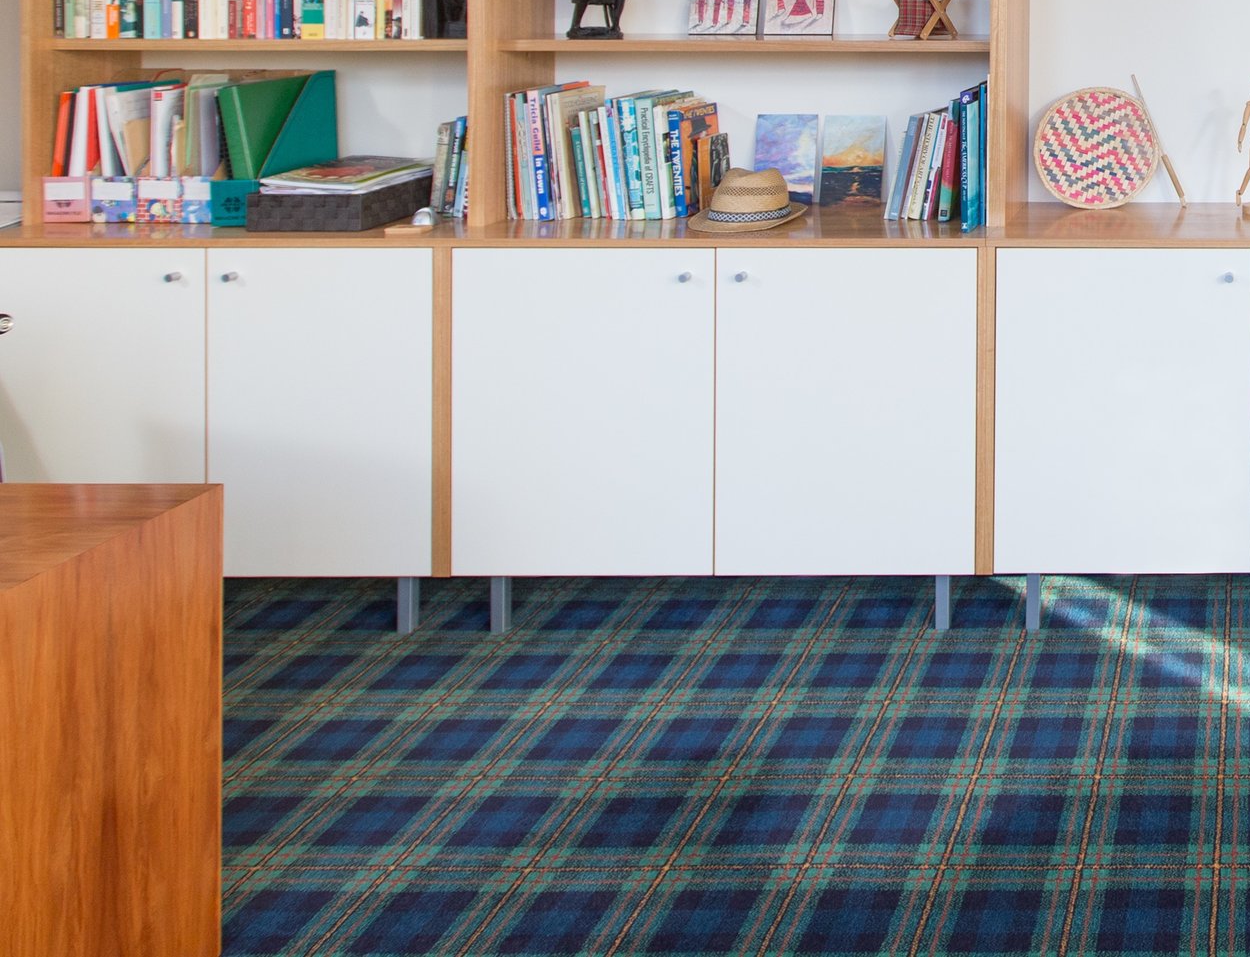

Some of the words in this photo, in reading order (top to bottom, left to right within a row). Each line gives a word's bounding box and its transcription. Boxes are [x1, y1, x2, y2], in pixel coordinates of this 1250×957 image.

[529, 97, 539, 124] Tricia
[639, 107, 650, 130] Practical
[927, 116, 935, 131] THE
[532, 126, 542, 152] Guild
[640, 131, 653, 164] Encyclopedia
[669, 129, 680, 149] THE
[922, 132, 931, 155] STORY
[920, 155, 927, 164] OF
[535, 169, 547, 194] town
[671, 149, 683, 196] TWENTIES
